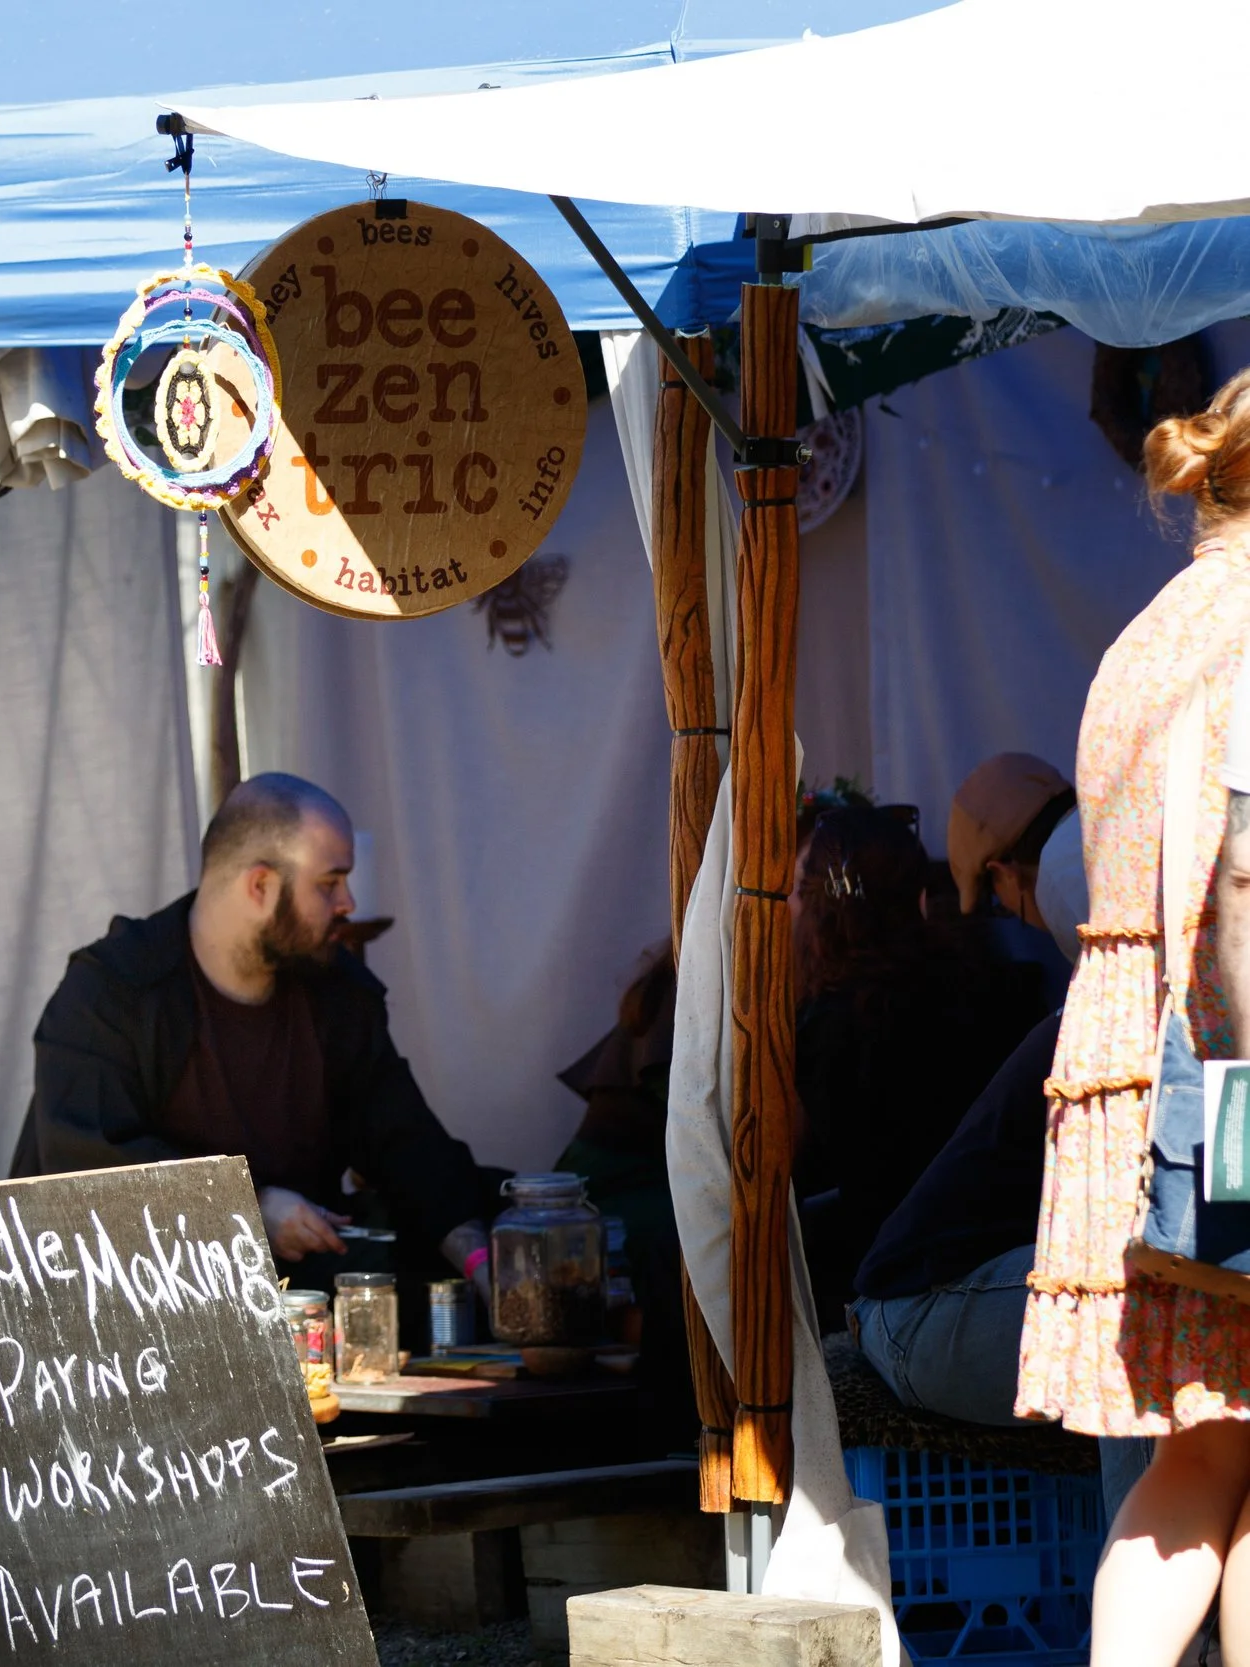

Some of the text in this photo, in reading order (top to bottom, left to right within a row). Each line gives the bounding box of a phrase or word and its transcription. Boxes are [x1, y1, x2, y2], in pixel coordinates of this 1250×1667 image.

[356, 217, 433, 248] bees
[311, 264, 476, 348] bee
[494, 264, 559, 362] hives
[314, 361, 489, 425] zen
[291, 431, 498, 516] tric
[518, 445, 567, 521] info
[334, 556, 468, 597] habitat
[73, 1203, 284, 1322] Making
[2, 1428, 298, 1521] WORKSHOPS
